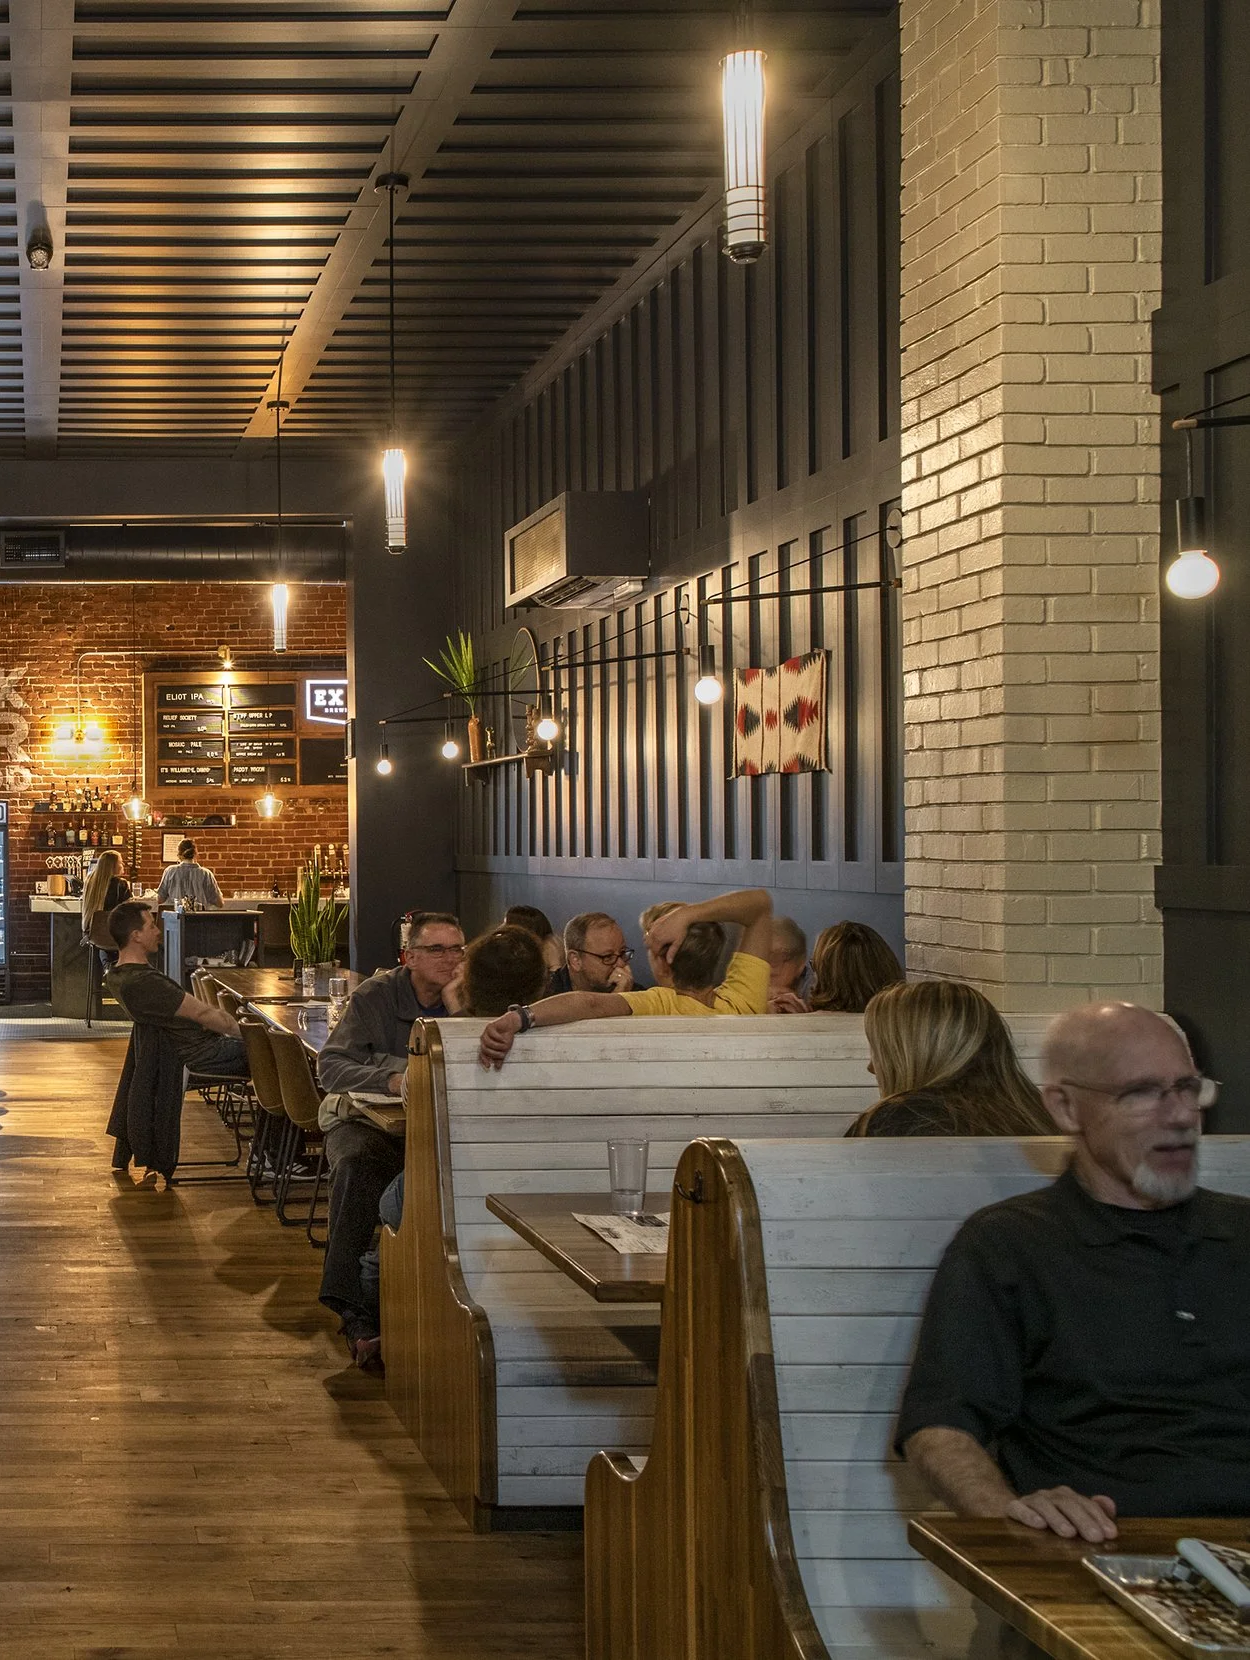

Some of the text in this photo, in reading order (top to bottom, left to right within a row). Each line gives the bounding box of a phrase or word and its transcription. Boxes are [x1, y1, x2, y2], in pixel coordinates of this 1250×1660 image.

[166, 693, 204, 701] ELIOT IPA
[314, 688, 344, 706] EX
